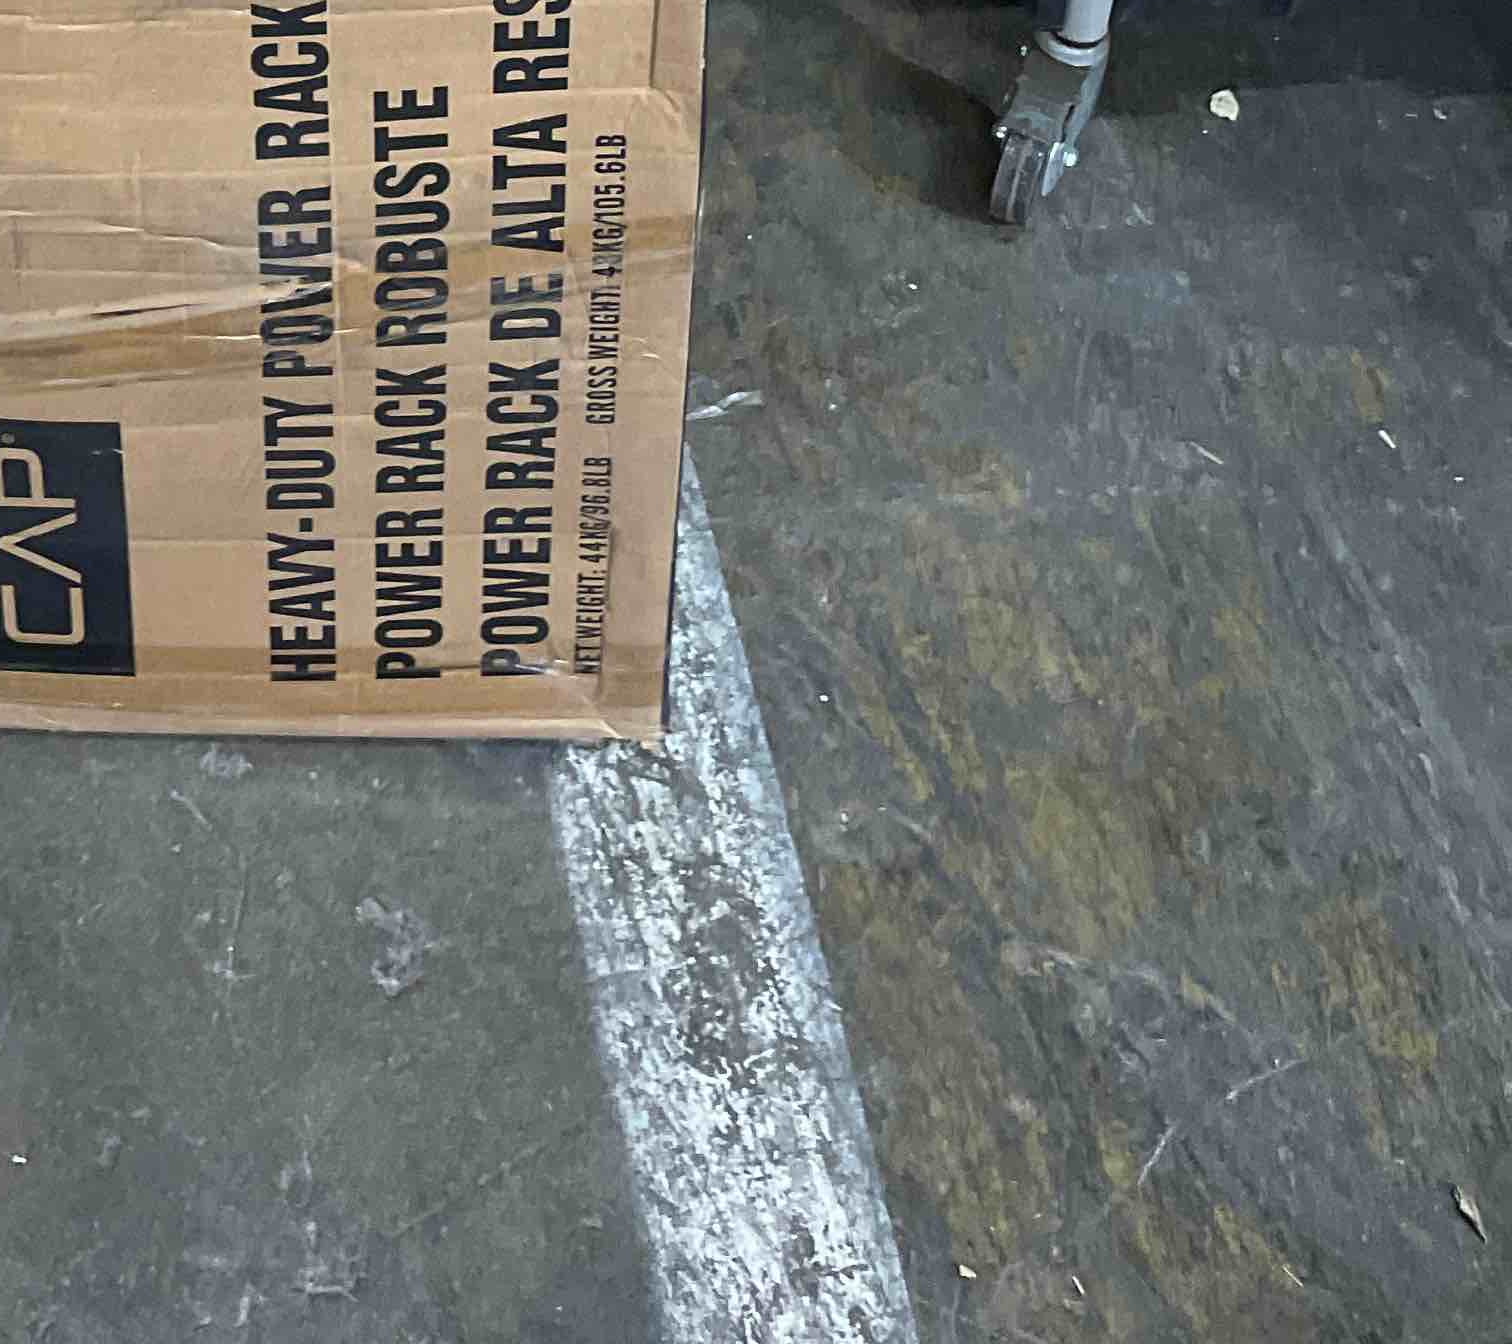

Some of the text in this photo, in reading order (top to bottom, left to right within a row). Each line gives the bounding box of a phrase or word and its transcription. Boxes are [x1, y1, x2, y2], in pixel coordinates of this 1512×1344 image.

[490, 113, 568, 252] ALTA
[250, 0, 337, 681] HEAVY-DUTY POWER RACK
[374, 86, 450, 680] POWER RACK ROBUSTE
[489, 272, 564, 340] DE
[484, 359, 561, 490] RACK
[585, 366, 617, 424] GROSS
[481, 507, 552, 676] POWER
[574, 457, 612, 673] NET WEIGHT: 44KG/96.8LB
